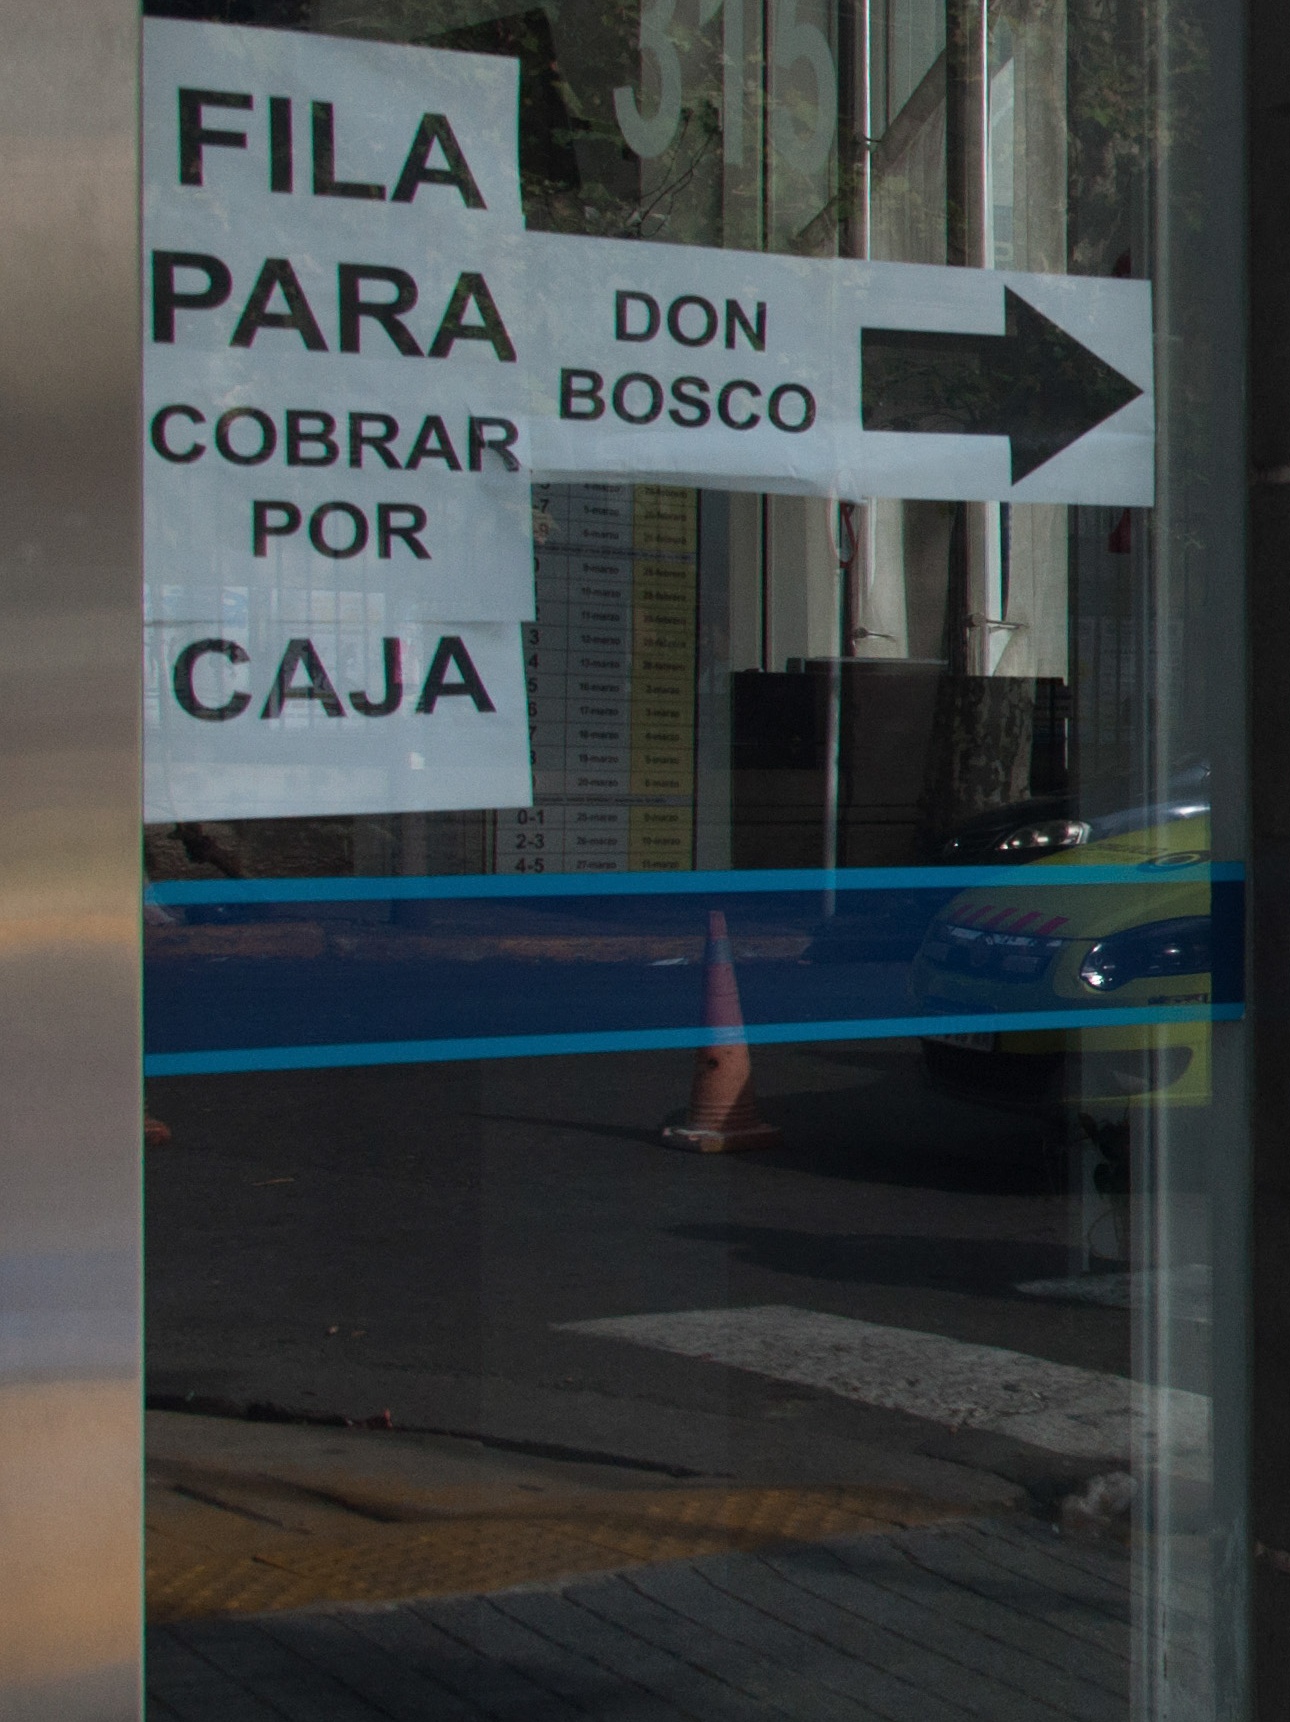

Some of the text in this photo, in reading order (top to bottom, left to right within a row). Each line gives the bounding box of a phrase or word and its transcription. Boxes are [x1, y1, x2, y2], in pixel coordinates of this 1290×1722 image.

[178, 87, 486, 209] FILA
[152, 250, 516, 362] PARA
[616, 290, 766, 351] DON
[560, 368, 816, 433] BOSCO
[150, 404, 520, 472] COBRAR
[253, 500, 431, 559] POR
[528, 654, 538, 669] 4
[529, 628, 540, 645] 3
[173, 636, 496, 721] CAJA
[528, 677, 538, 693] 5
[515, 833, 544, 850] 2-3
[517, 809, 544, 825] 0-1
[514, 857, 544, 873] 4-5
